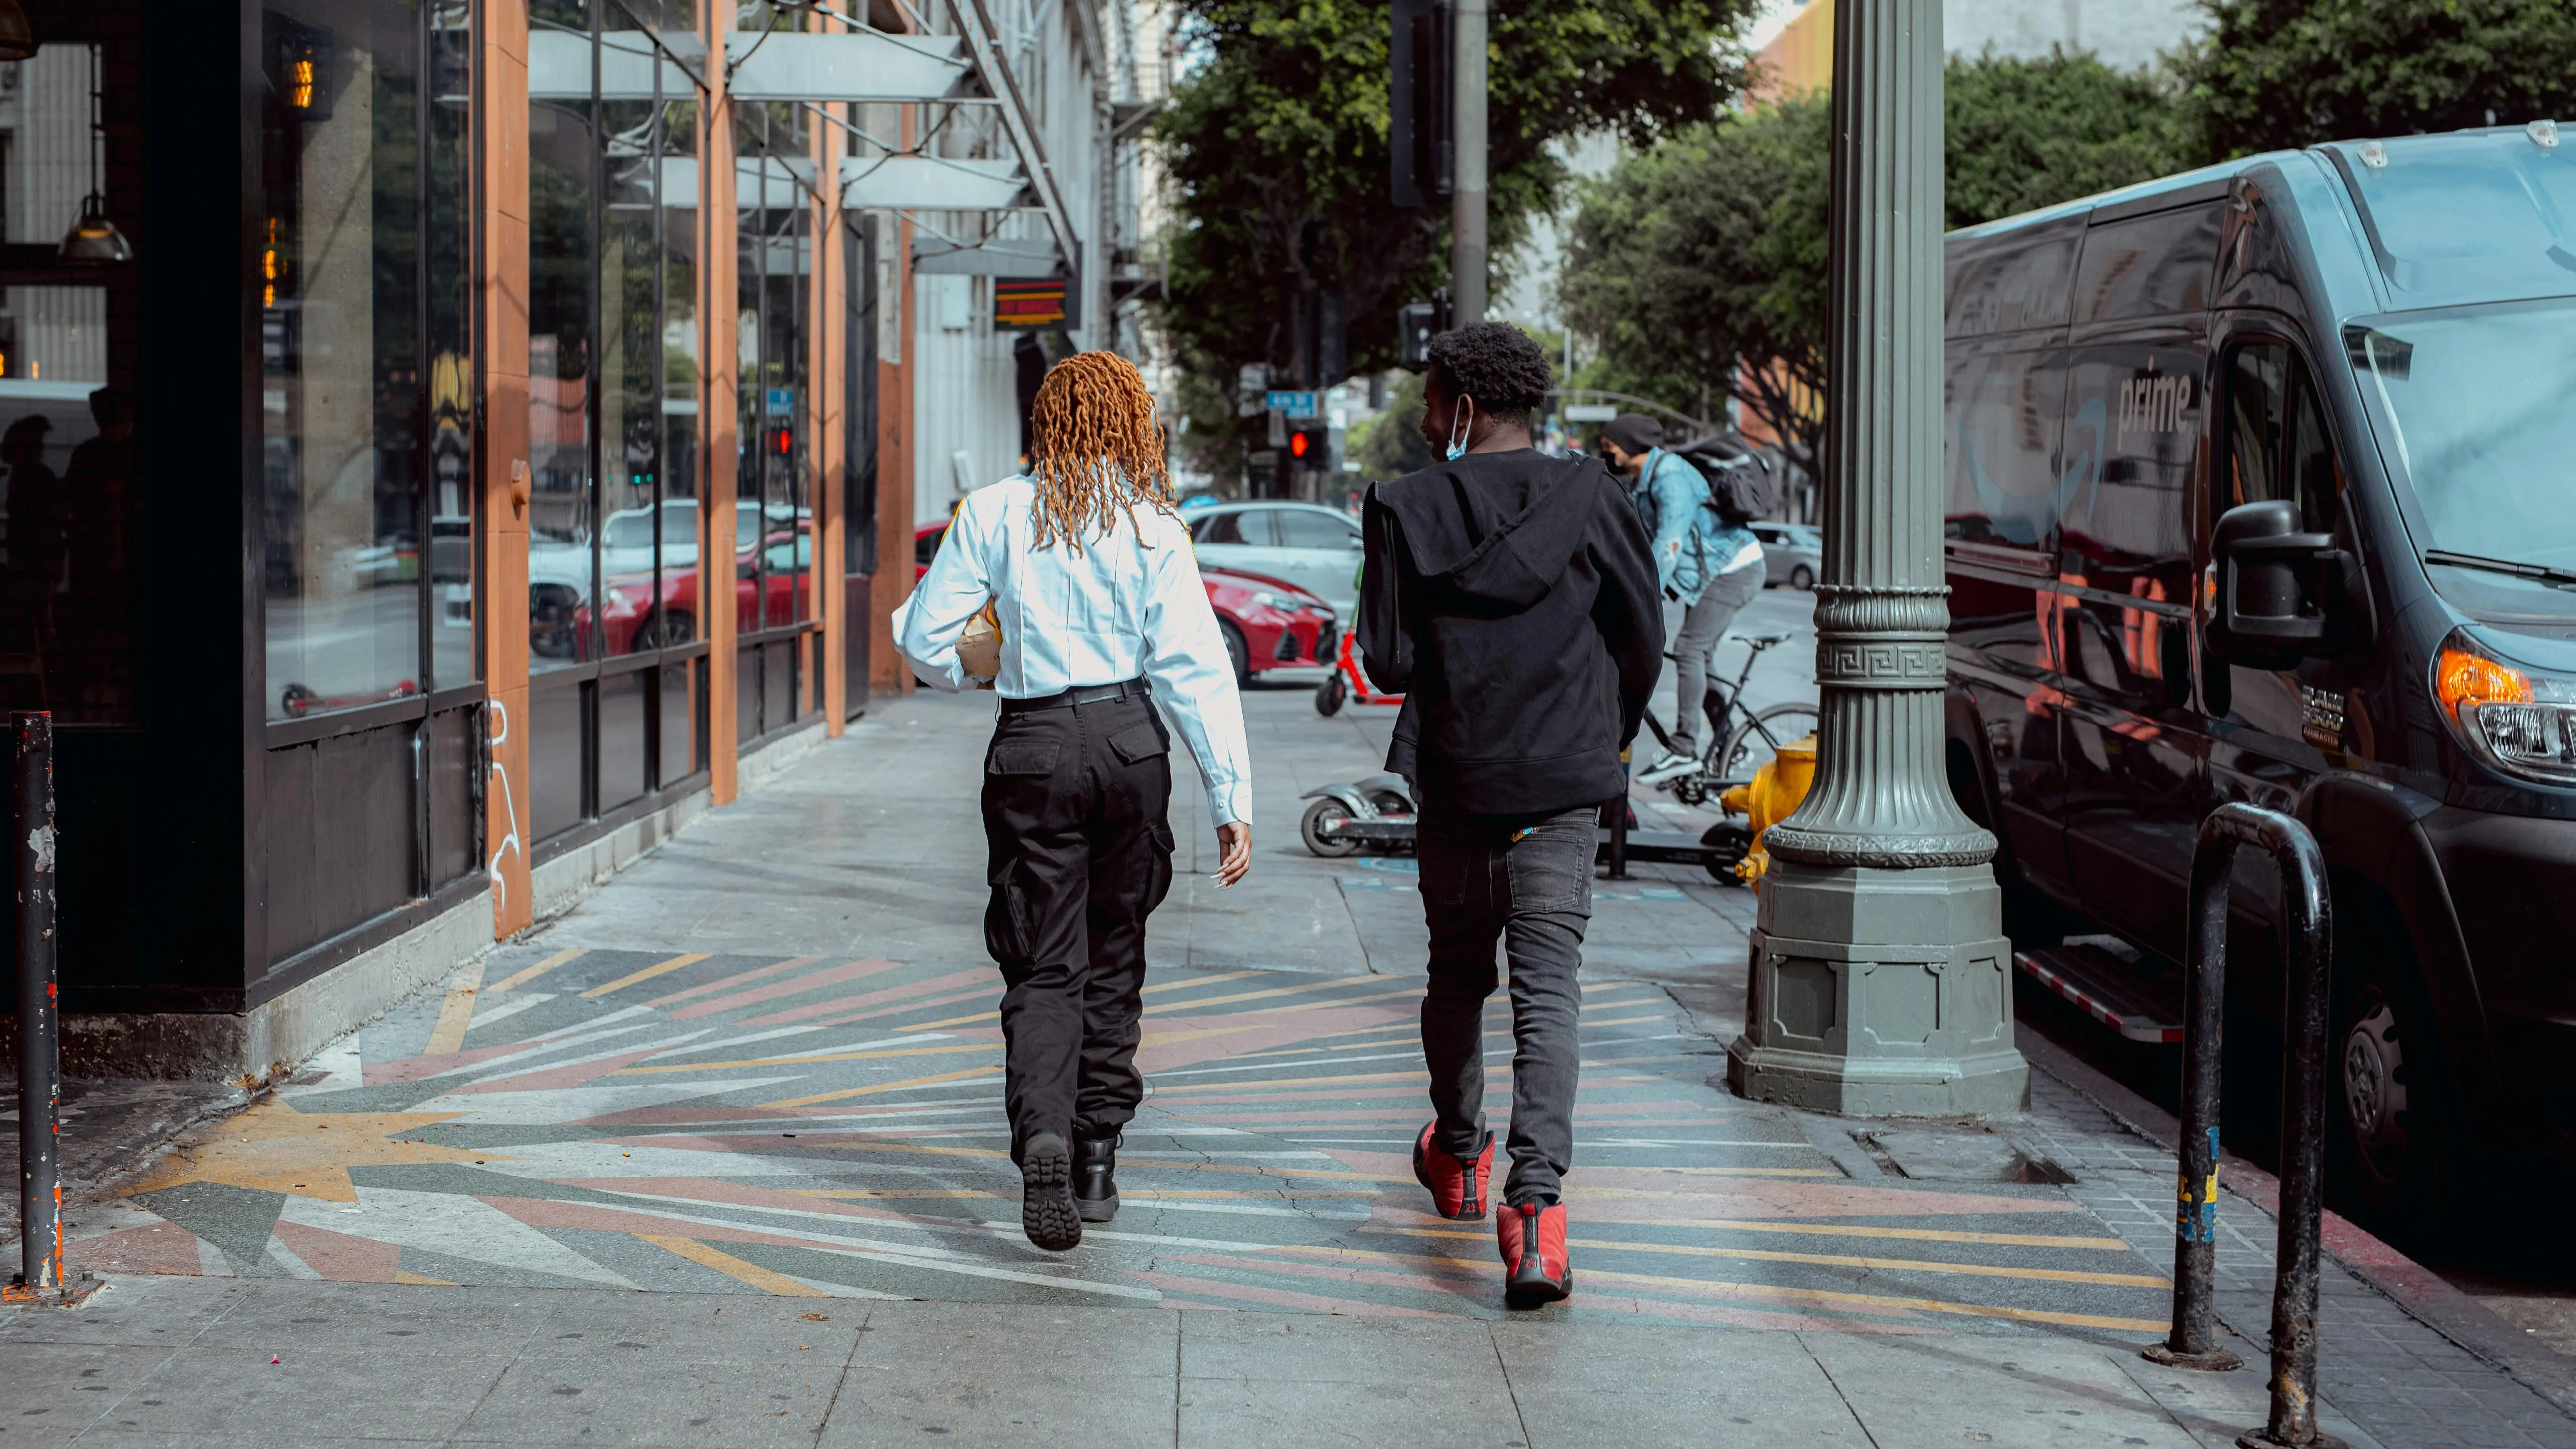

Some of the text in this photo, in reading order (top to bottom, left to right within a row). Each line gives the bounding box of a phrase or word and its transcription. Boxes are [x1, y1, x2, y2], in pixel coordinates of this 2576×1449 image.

[2118, 355, 2191, 453] prime
[2302, 685, 2344, 714] RAM
[1465, 1203, 1476, 1213] 23
[1524, 1257, 1537, 1268] 23
